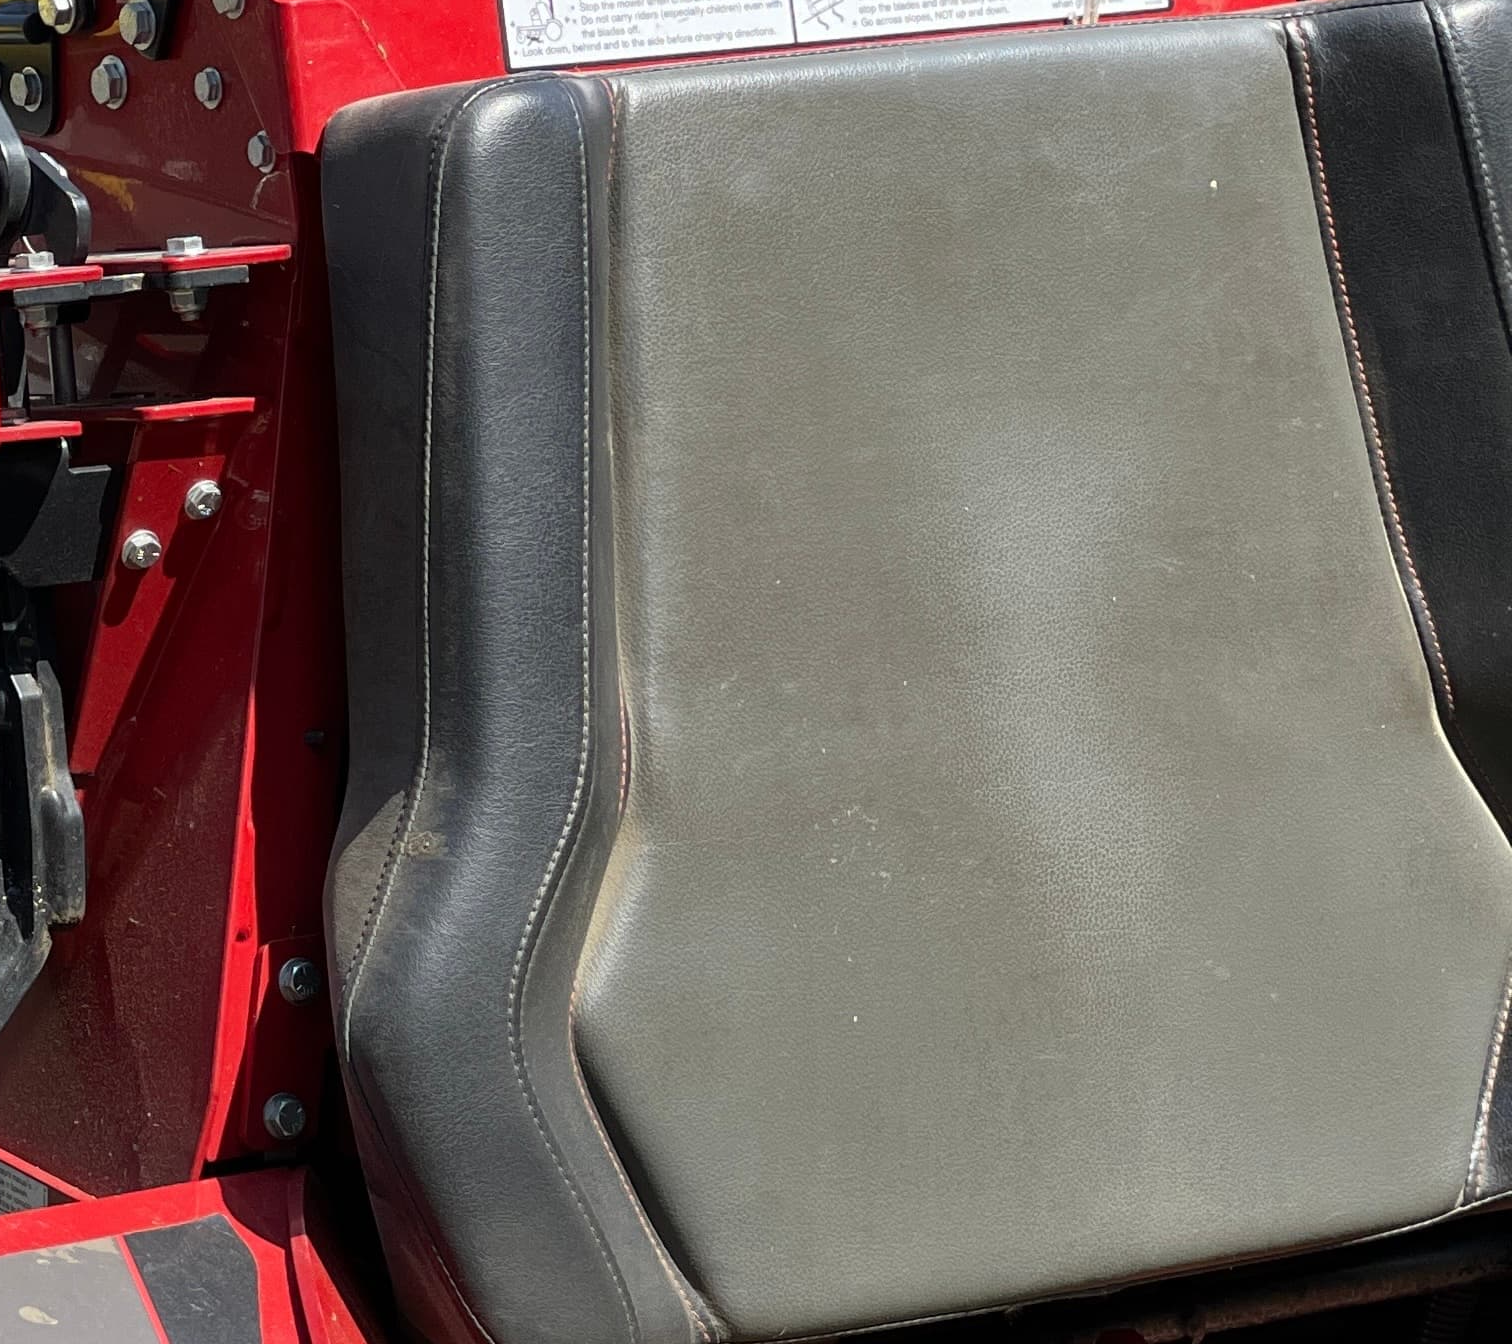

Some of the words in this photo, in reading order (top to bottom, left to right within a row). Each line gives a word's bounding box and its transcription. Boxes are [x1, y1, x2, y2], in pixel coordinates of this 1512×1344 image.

[578, 1, 600, 12] Stop
[600, 0, 615, 10] the
[616, 0, 644, 8] mower
[580, 15, 593, 25] Do
[595, 14, 609, 24] not
[610, 13, 632, 23] carry
[634, 10, 658, 20] riders
[660, 6, 704, 19] (especially
[705, 2, 741, 14] children)
[743, 2, 763, 11] even
[877, 3, 891, 12] the
[860, 16, 873, 27] Go
[934, 8, 953, 20] NOT
[955, 9, 966, 19] up
[967, 6, 983, 17] and
[580, 28, 595, 38] the
[596, 26, 625, 37] blades
[626, 24, 640, 34] off.
[521, 46, 543, 57] Look
[571, 41, 601, 52] behind
[603, 39, 619, 50] and
[620, 39, 630, 48] to
[630, 37, 645, 47] the
[646, 35, 664, 46] side
[666, 33, 693, 44] before
[694, 30, 733, 41] changing
